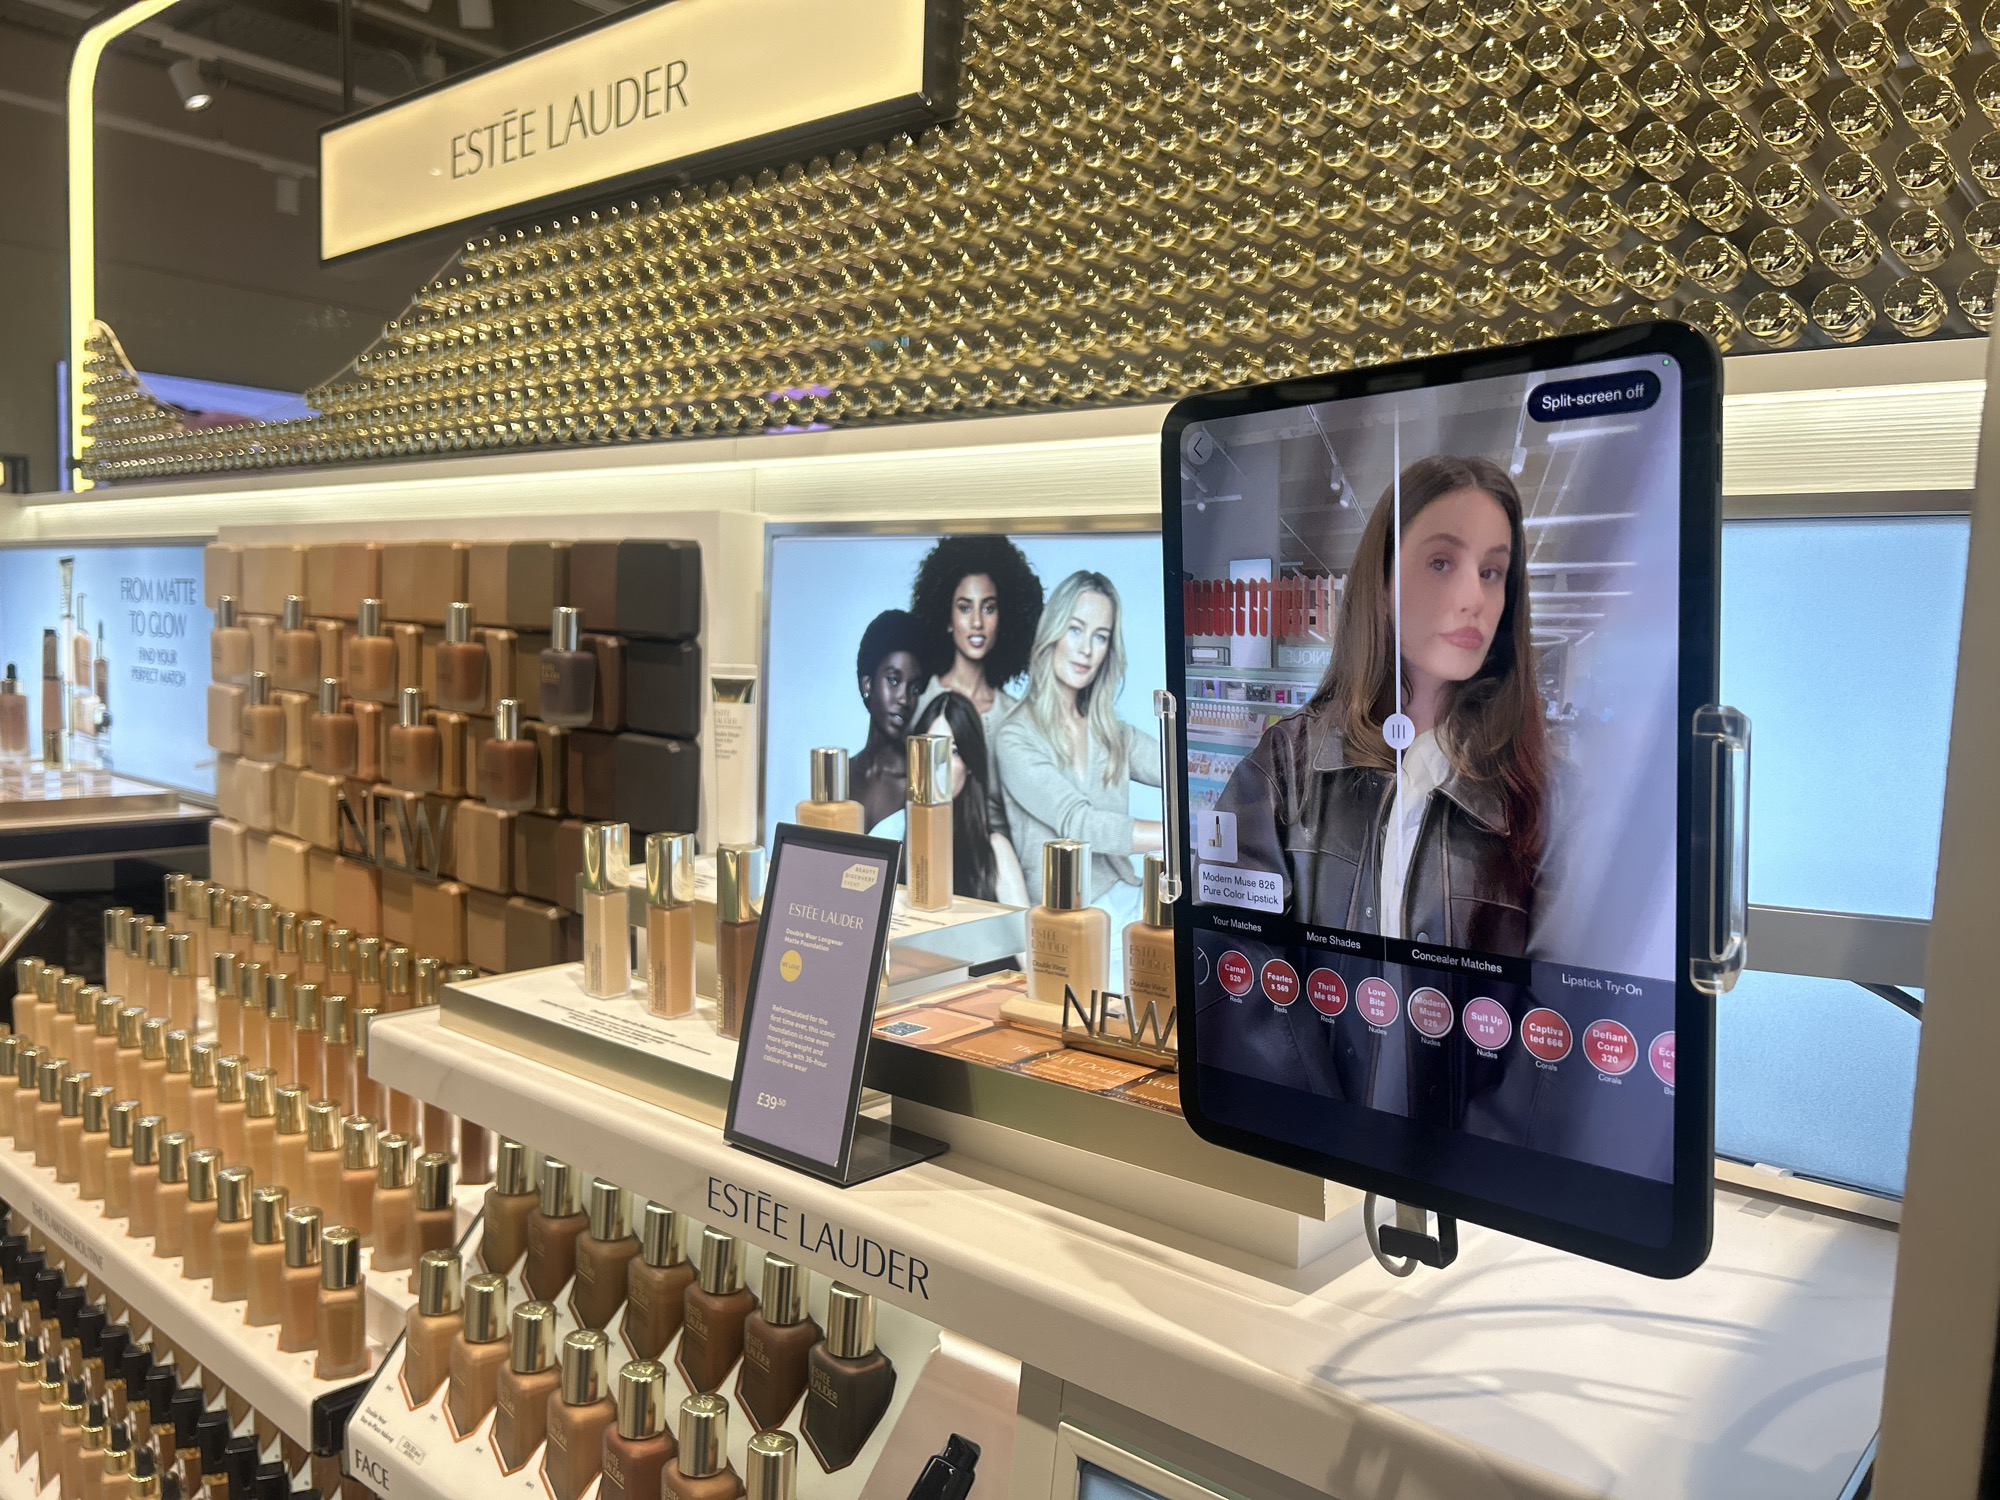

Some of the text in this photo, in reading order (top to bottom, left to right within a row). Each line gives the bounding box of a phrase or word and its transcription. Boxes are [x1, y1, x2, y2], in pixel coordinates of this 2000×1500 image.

[547, 59, 690, 150] LAUDER
[1542, 382, 1645, 412] Split-screen off
[121, 577, 197, 605] FROM MATTE
[129, 610, 187, 639] TO GLOW
[337, 790, 448, 880] NEW
[845, 872, 875, 883] DISCOVERY
[855, 867, 876, 875] BEAUTY
[843, 880, 861, 888] EVENT
[1203, 871, 1276, 890] Modern Muse 826
[1203, 885, 1279, 905] Pure Color Lipstick
[821, 909, 864, 930] LAUDER
[1212, 915, 1262, 932] Your Matches
[784, 936, 829, 952] Matte Foundation
[785, 928, 844, 947] Double Wear Longwear
[1306, 931, 1361, 950] More Shades
[1032, 960, 1067, 972] Double Wear
[1225, 963, 1246, 974] Carnal
[1412, 949, 1502, 974] Concealer Matches
[1230, 974, 1241, 983] 520
[1267, 972, 1293, 983] Fearles
[1130, 978, 1168, 992] Double Wear
[1277, 984, 1289, 993] 569
[1318, 982, 1336, 992] Thrill
[1368, 987, 1386, 997] Love
[1561, 973, 1643, 997] Lipstick Try-On
[1230, 995, 1243, 1004] Reds
[1314, 991, 1340, 1003] Me 699
[1369, 997, 1385, 1007] Bite
[1414, 996, 1446, 1009] Modern
[772, 1004, 828, 1026] Reformulated for the
[1274, 1005, 1287, 1014] Reds
[1371, 1008, 1384, 1017] 836
[1419, 1007, 1442, 1018] Muse
[1062, 983, 1177, 1052] NEW
[1321, 1015, 1335, 1024] Reds
[1423, 1019, 1438, 1028] 826
[1471, 1012, 1503, 1027] Suit Up
[770, 1013, 782, 1023] first
[782, 1018, 794, 1027] time
[809, 1025, 819, 1034] this
[819, 1028, 836, 1039] iconic
[1368, 1026, 1388, 1036] Nudes
[1479, 1024, 1494, 1034] 816
[1529, 1022, 1563, 1037] Captiva
[768, 1023, 798, 1038] foundation
[804, 1035, 816, 1044] now
[816, 1039, 830, 1048] even
[1421, 1036, 1441, 1047] Nudes
[1530, 1034, 1563, 1048] ted 666
[1592, 1029, 1628, 1044] Defiant
[767, 1034, 824, 1056] more lightweight and
[1597, 1041, 1623, 1054] Coral
[765, 1044, 828, 1068] hydrating, with 36-hour
[1476, 1048, 1498, 1059] Nudes
[1601, 1054, 1618, 1064] 320
[763, 1054, 808, 1072] colour-true wear
[1535, 1060, 1558, 1072] Corals
[1598, 1073, 1622, 1085] Corals
[800, 1213, 929, 1300] LAUDER
[355, 1449, 390, 1491] FACE
